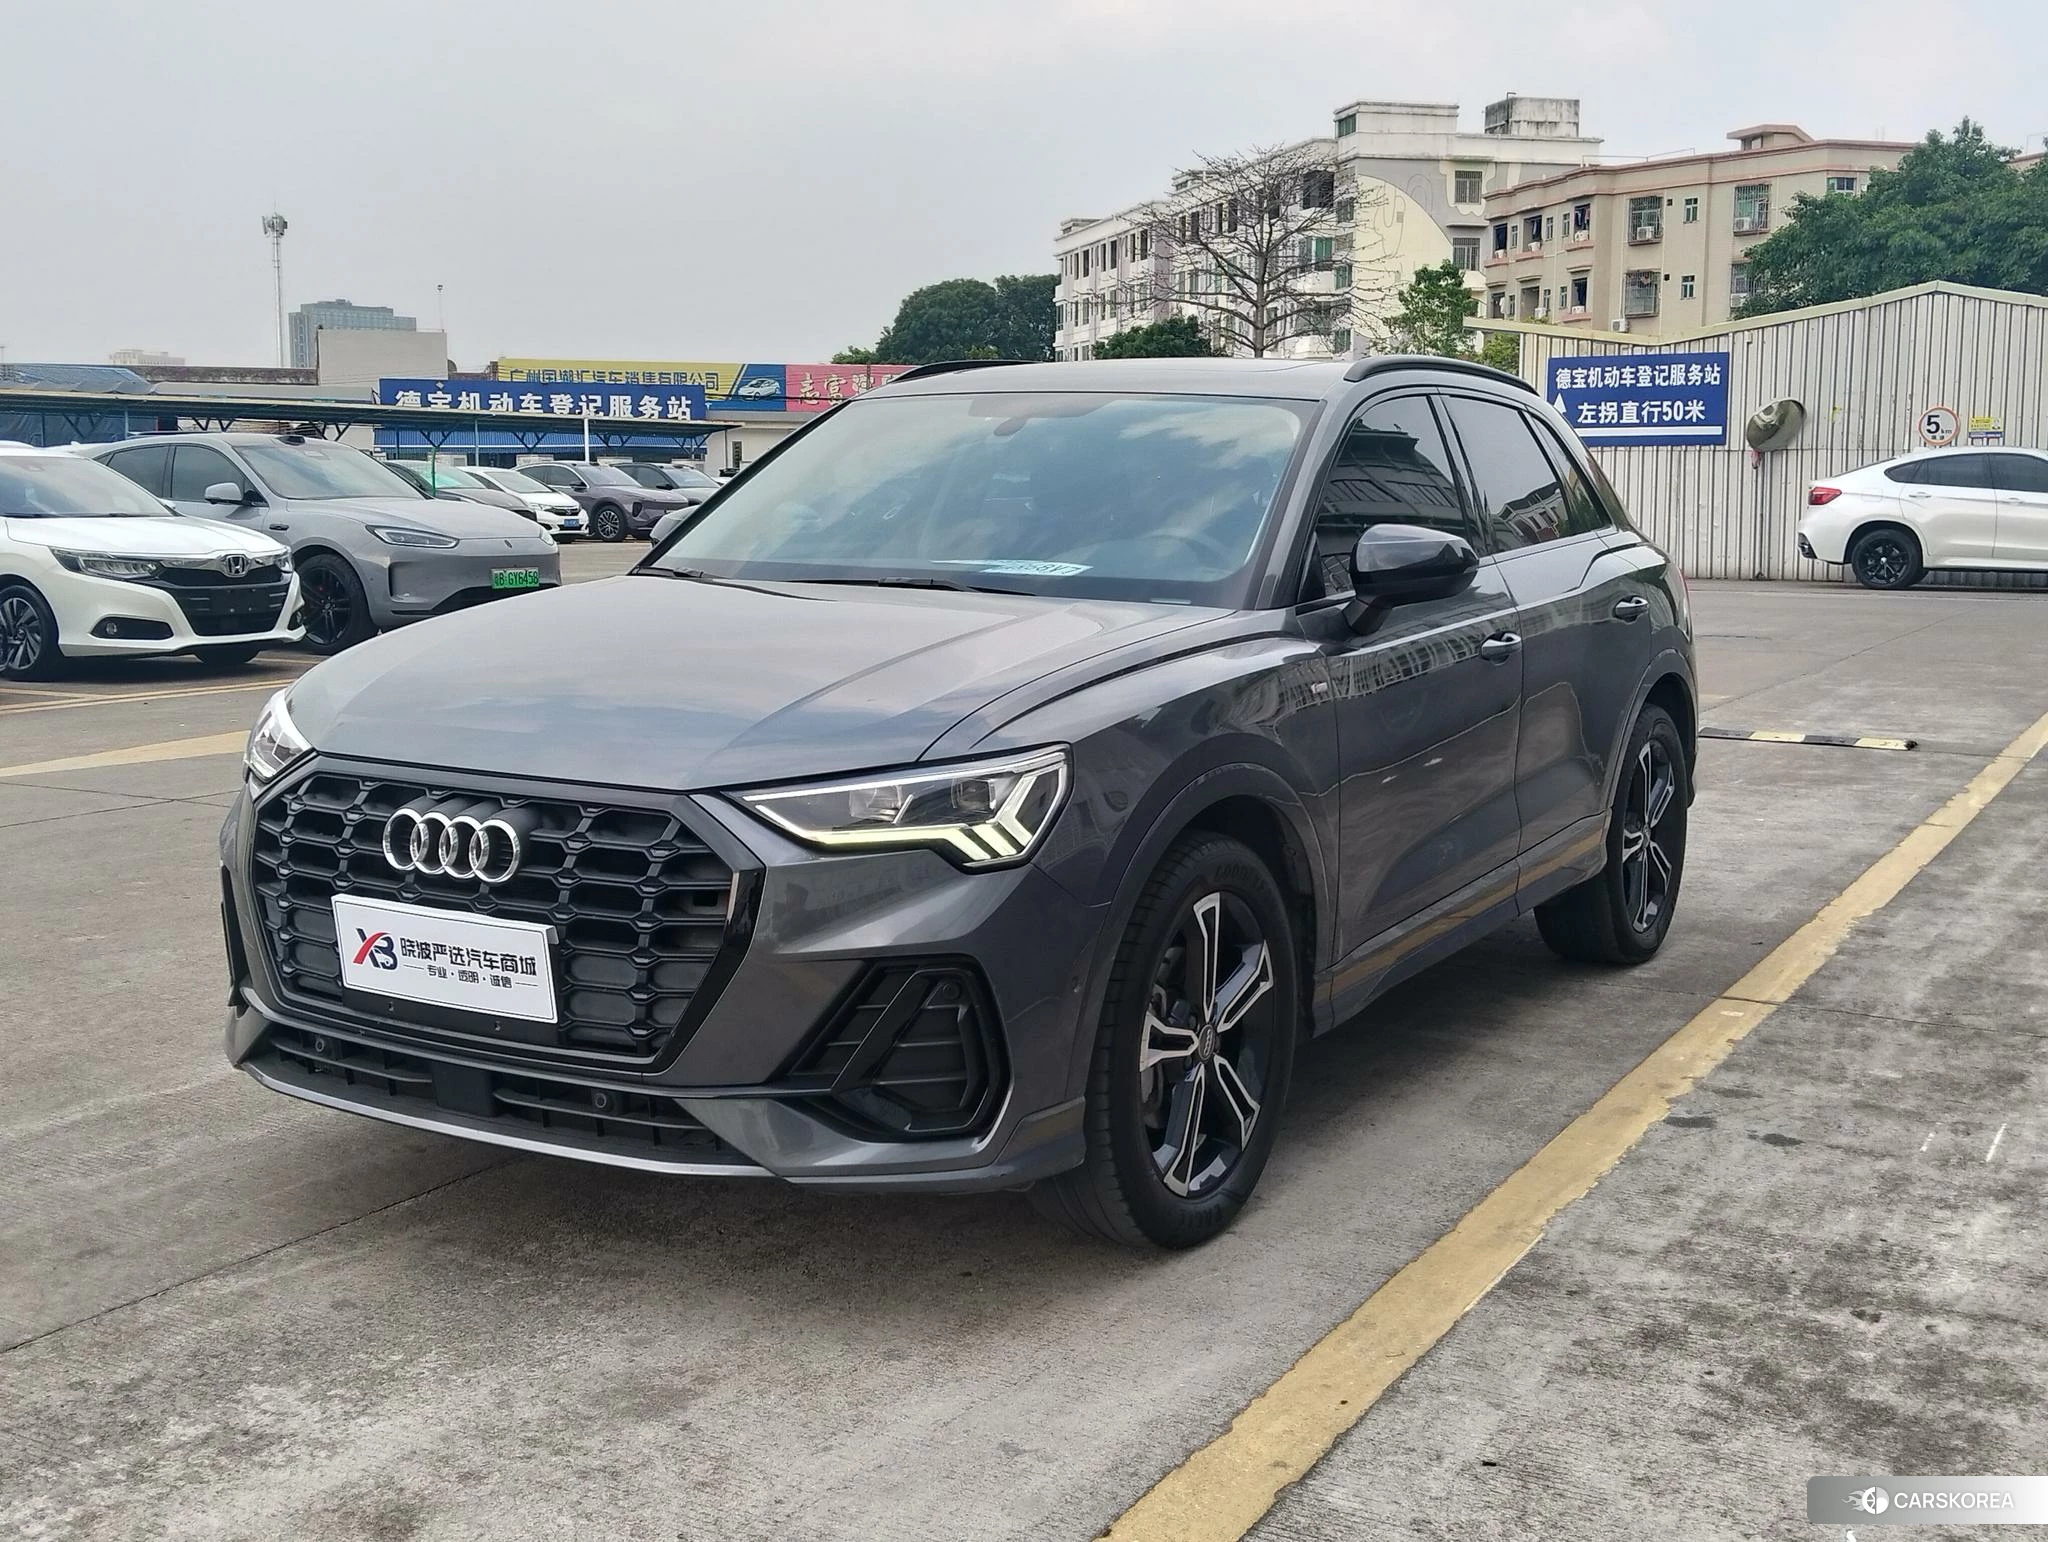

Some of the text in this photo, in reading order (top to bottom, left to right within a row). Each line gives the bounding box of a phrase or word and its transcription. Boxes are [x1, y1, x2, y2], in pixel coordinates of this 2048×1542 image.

[1555, 363, 1721, 390] 德宝机动车登记服务站
[1577, 399, 1706, 424] 左拐直行50米
[1926, 415, 1940, 434] 5
[399, 936, 537, 976] 晓波严选汽车商城
